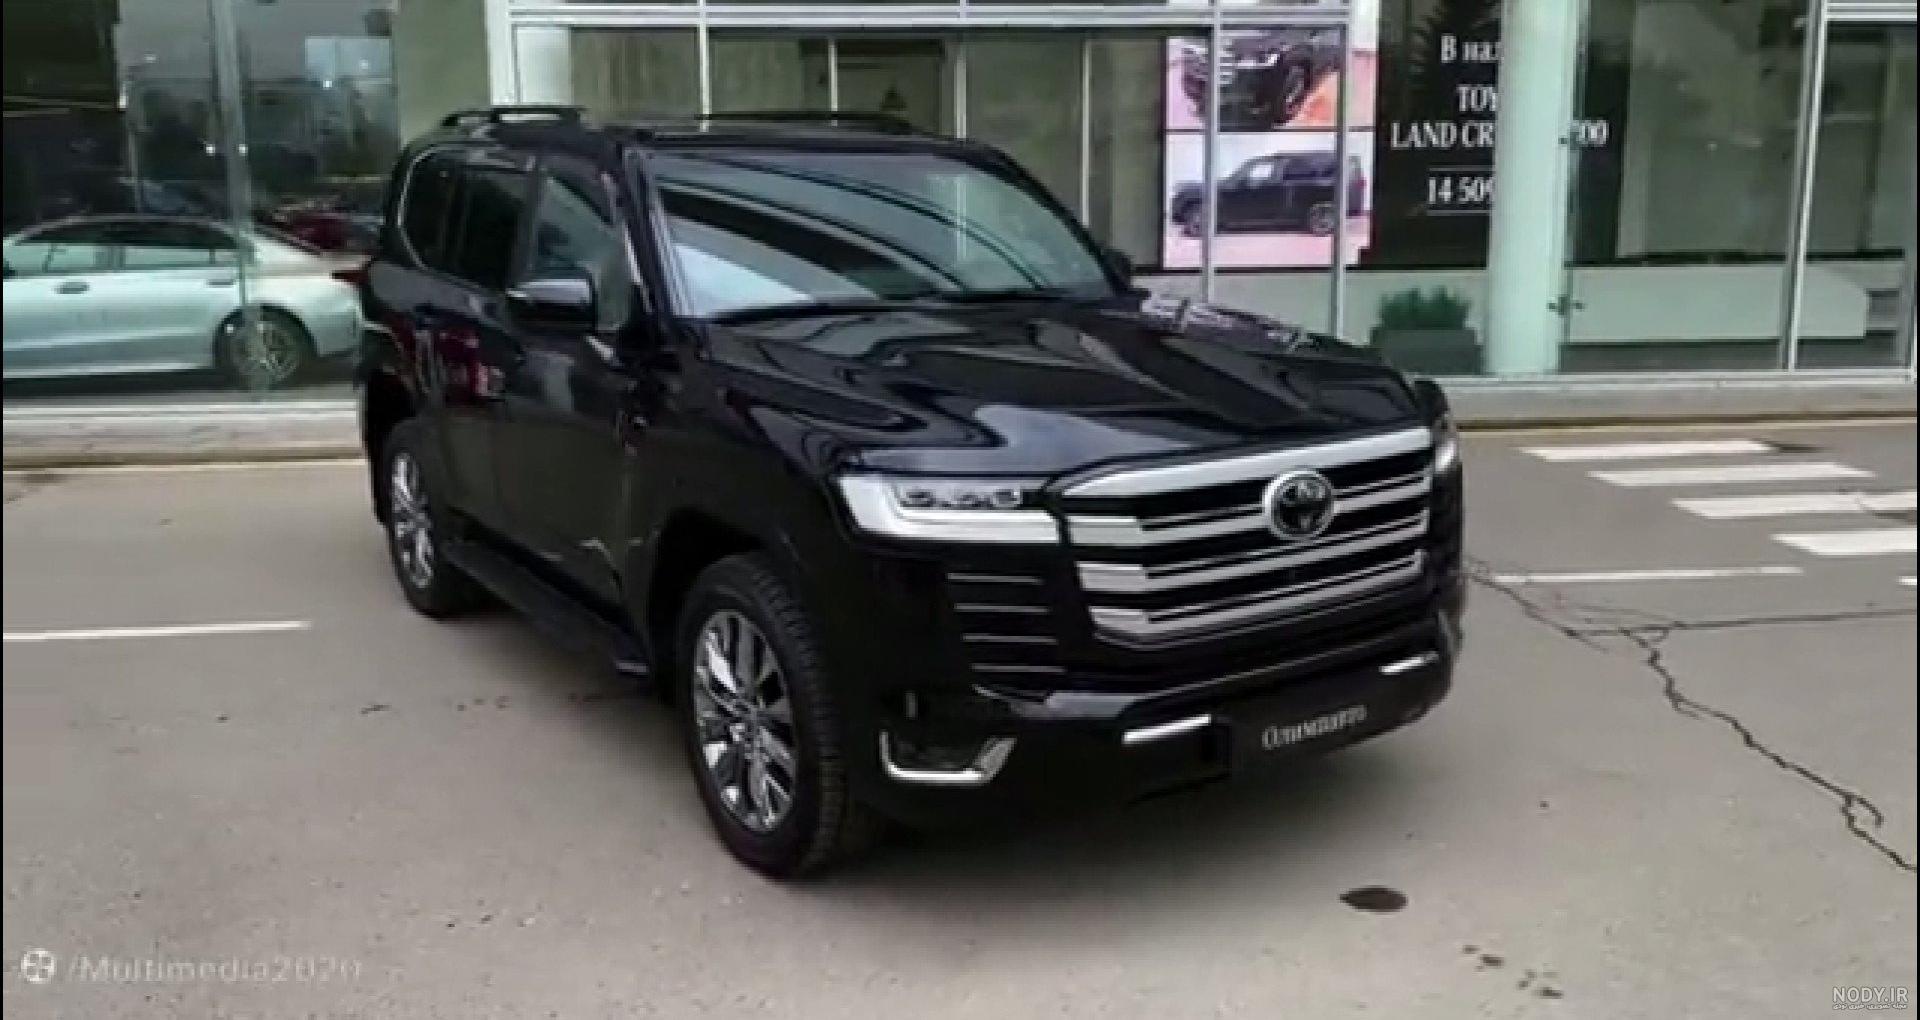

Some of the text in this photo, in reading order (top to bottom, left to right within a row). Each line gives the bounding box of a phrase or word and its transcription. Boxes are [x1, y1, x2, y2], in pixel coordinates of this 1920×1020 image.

[1456, 84, 1498, 112] TOY
[1391, 121, 1457, 148] LAND
[1462, 121, 1495, 148] CR
[1428, 177, 1494, 204] 14 509
